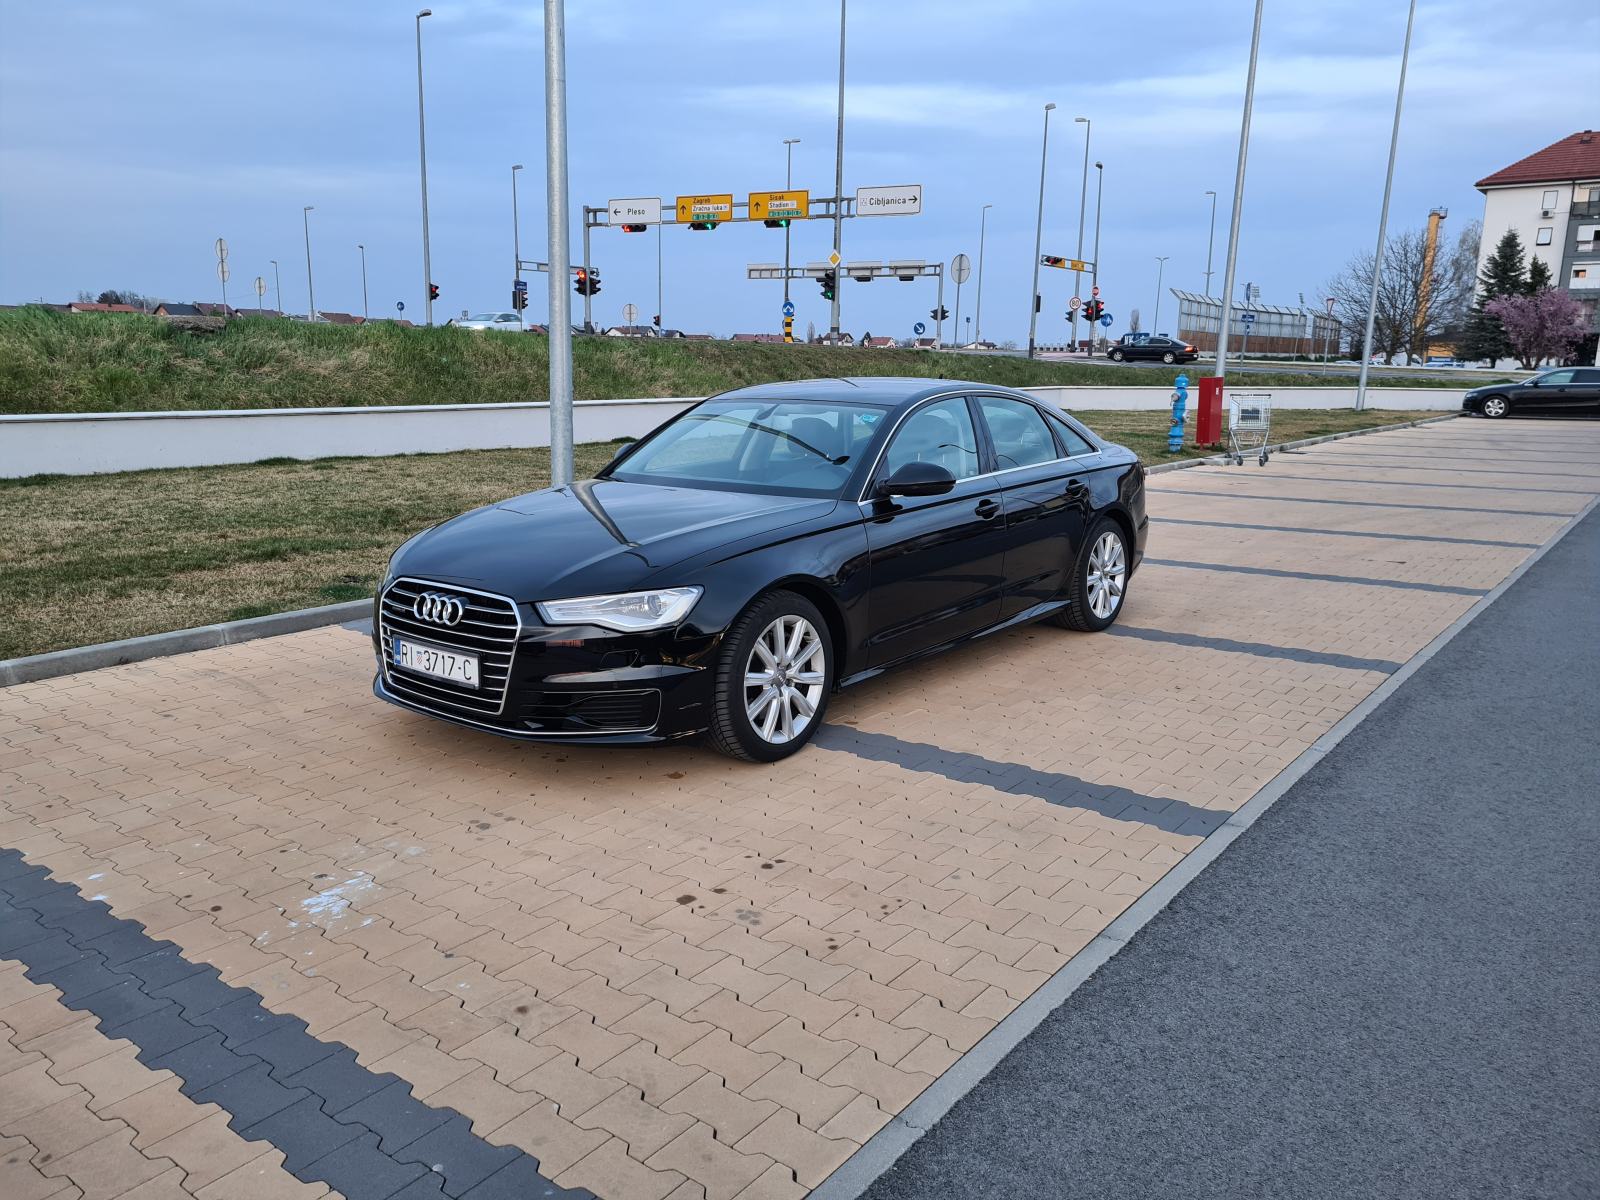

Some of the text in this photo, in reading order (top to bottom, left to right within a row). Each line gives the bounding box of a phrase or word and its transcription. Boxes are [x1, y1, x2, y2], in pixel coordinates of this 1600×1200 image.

[869, 197, 907, 207] Cibljanica
[627, 208, 645, 216] Pleso
[401, 644, 472, 680] RI 3717-C
